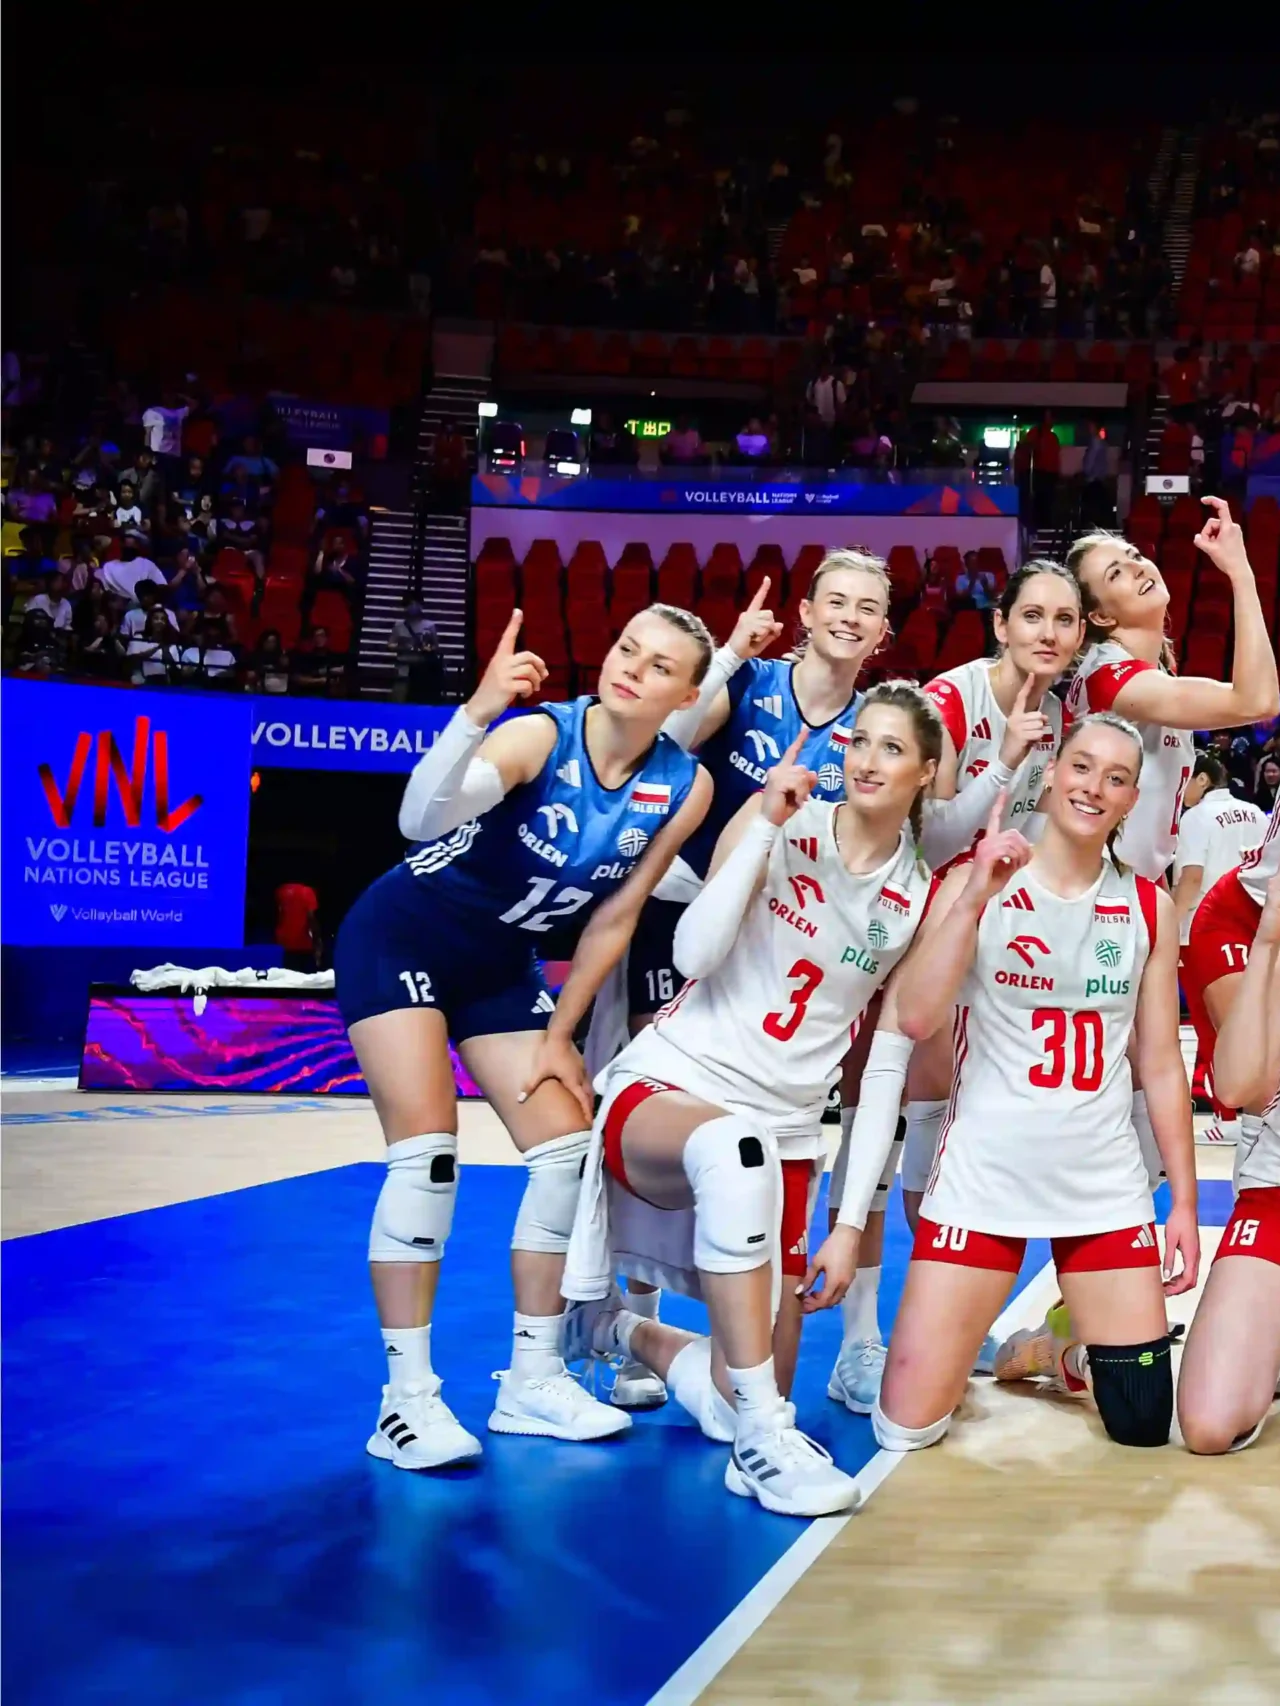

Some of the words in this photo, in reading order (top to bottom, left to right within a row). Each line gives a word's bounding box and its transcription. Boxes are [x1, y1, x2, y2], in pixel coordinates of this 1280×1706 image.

[685, 491, 769, 504] VOLLEYBALL
[38, 715, 204, 833] VNL
[1216, 809, 1257, 828] POLSKA
[26, 837, 210, 868] VOLLEYBALL
[518, 823, 569, 867] ORLEN
[24, 866, 121, 886] NATIONS
[130, 870, 209, 889] LEAGUE
[590, 862, 637, 880] plu
[72, 907, 138, 923] Volleyball
[141, 908, 183, 922] World
[498, 876, 594, 931] 12
[768, 897, 819, 938] ORLEN
[877, 897, 911, 917] POLSKA
[1094, 914, 1131, 925] POLSKA
[840, 946, 880, 975] plus
[1221, 943, 1248, 967] 17
[399, 971, 435, 1003] 12
[645, 968, 674, 1001] 16
[994, 970, 1055, 991] ORLEN
[1086, 975, 1131, 998] plus
[762, 958, 824, 1042] 3
[1028, 1007, 1105, 1092] 30
[1229, 1219, 1260, 1247] 15
